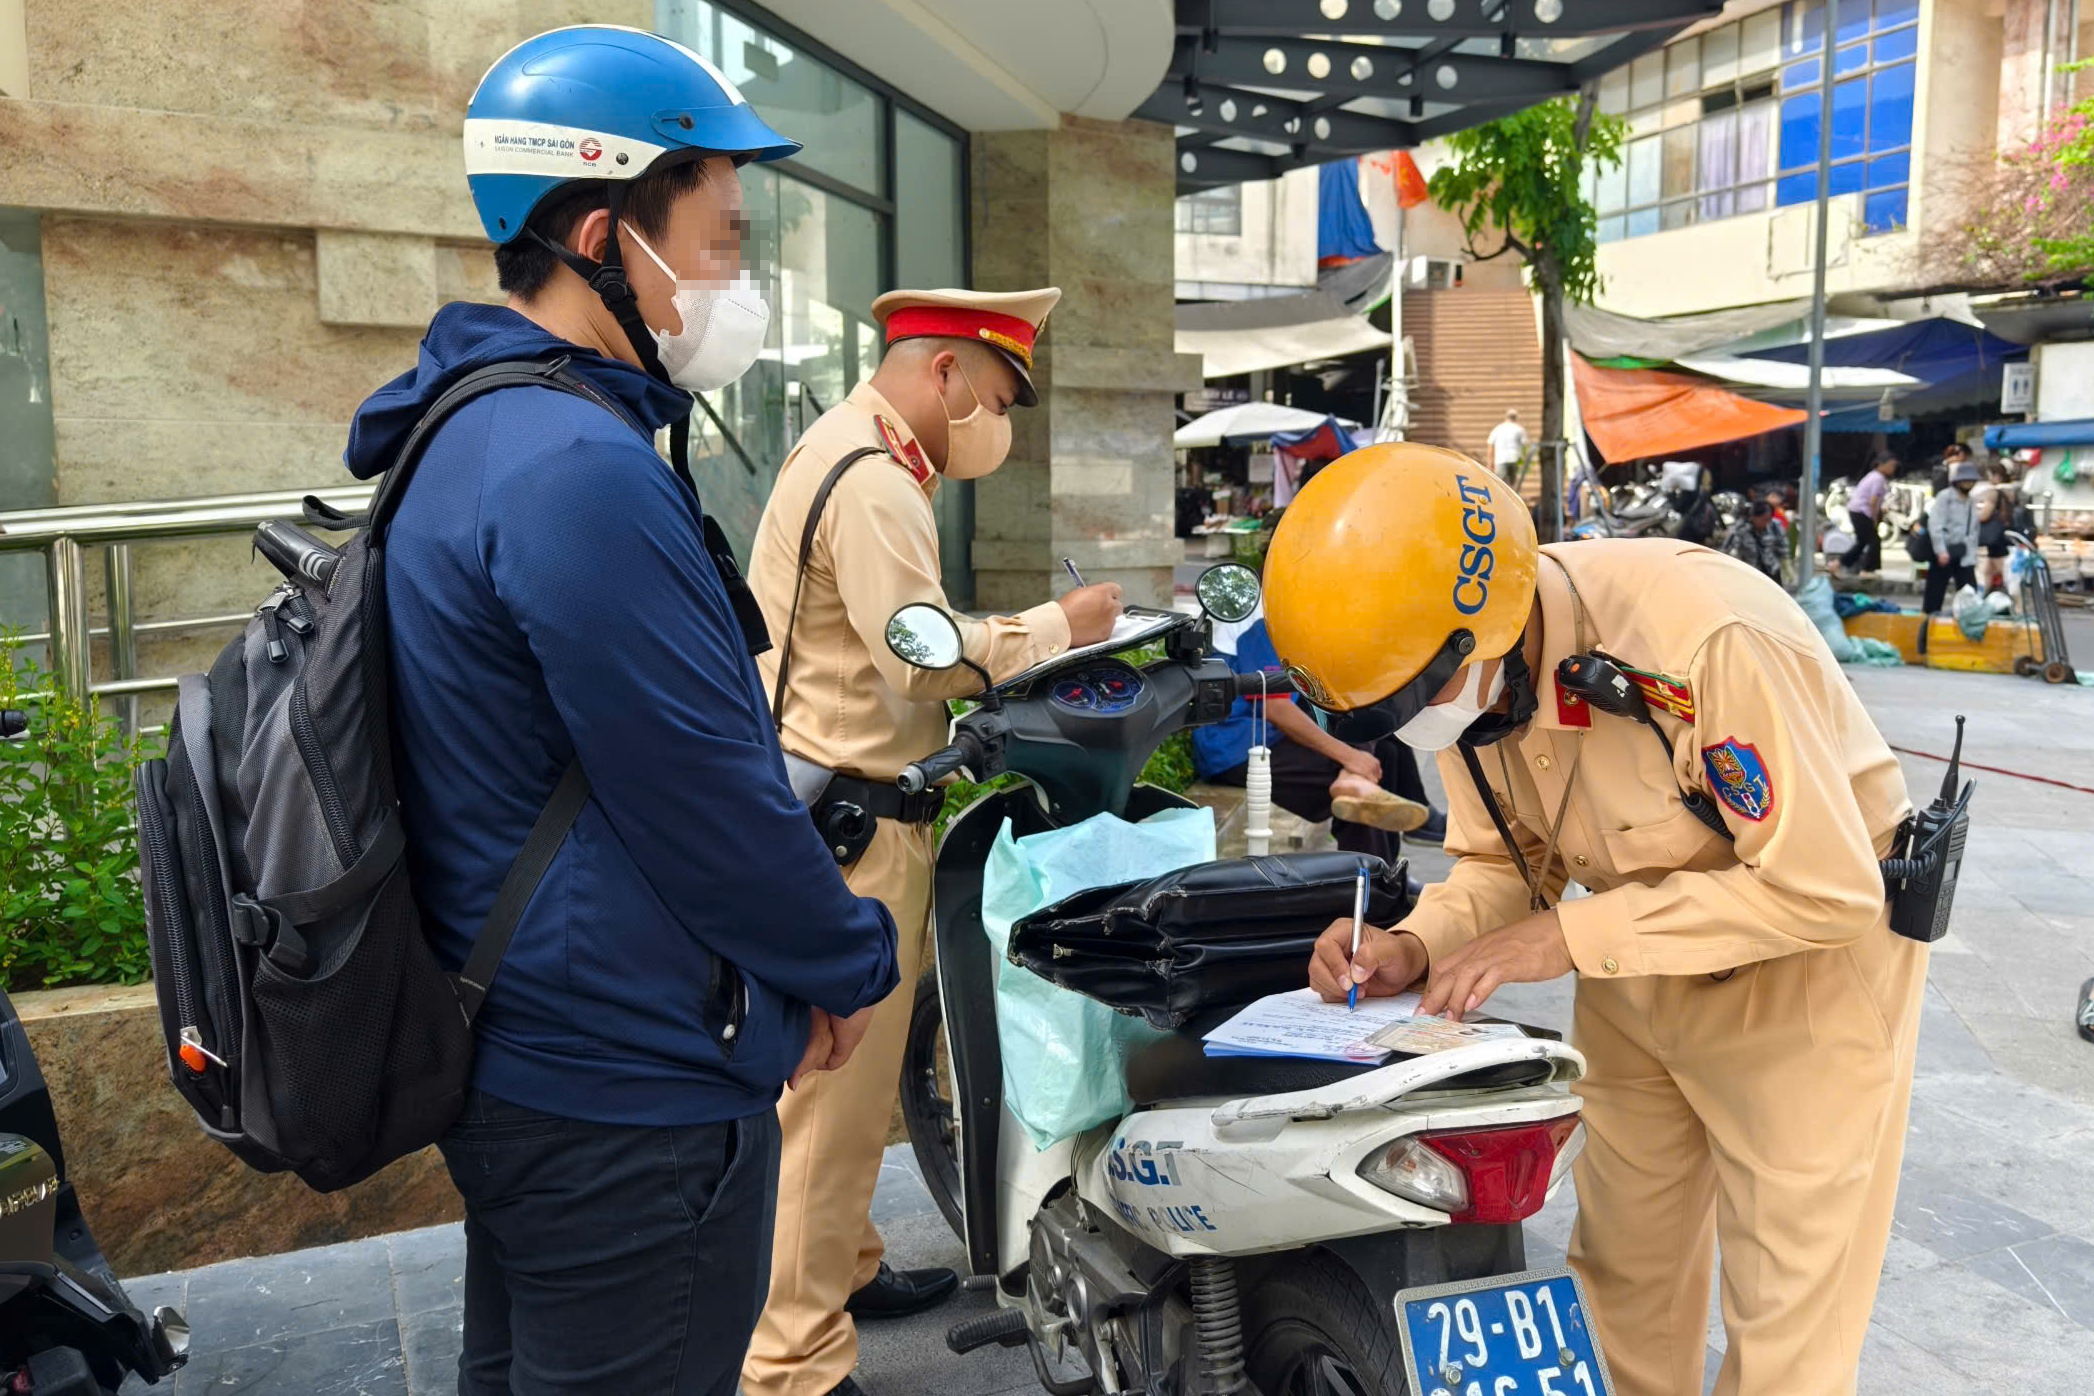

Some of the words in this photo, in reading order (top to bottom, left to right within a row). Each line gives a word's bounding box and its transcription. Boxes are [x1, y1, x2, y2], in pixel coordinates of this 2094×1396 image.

[515, 147, 555, 156] COMMERCIAL
[528, 137, 546, 147] TMCP
[1453, 474, 1497, 615] CSGT
[1147, 1205, 1217, 1232] POLICE
[1428, 1285, 1568, 1373] 29-B1
